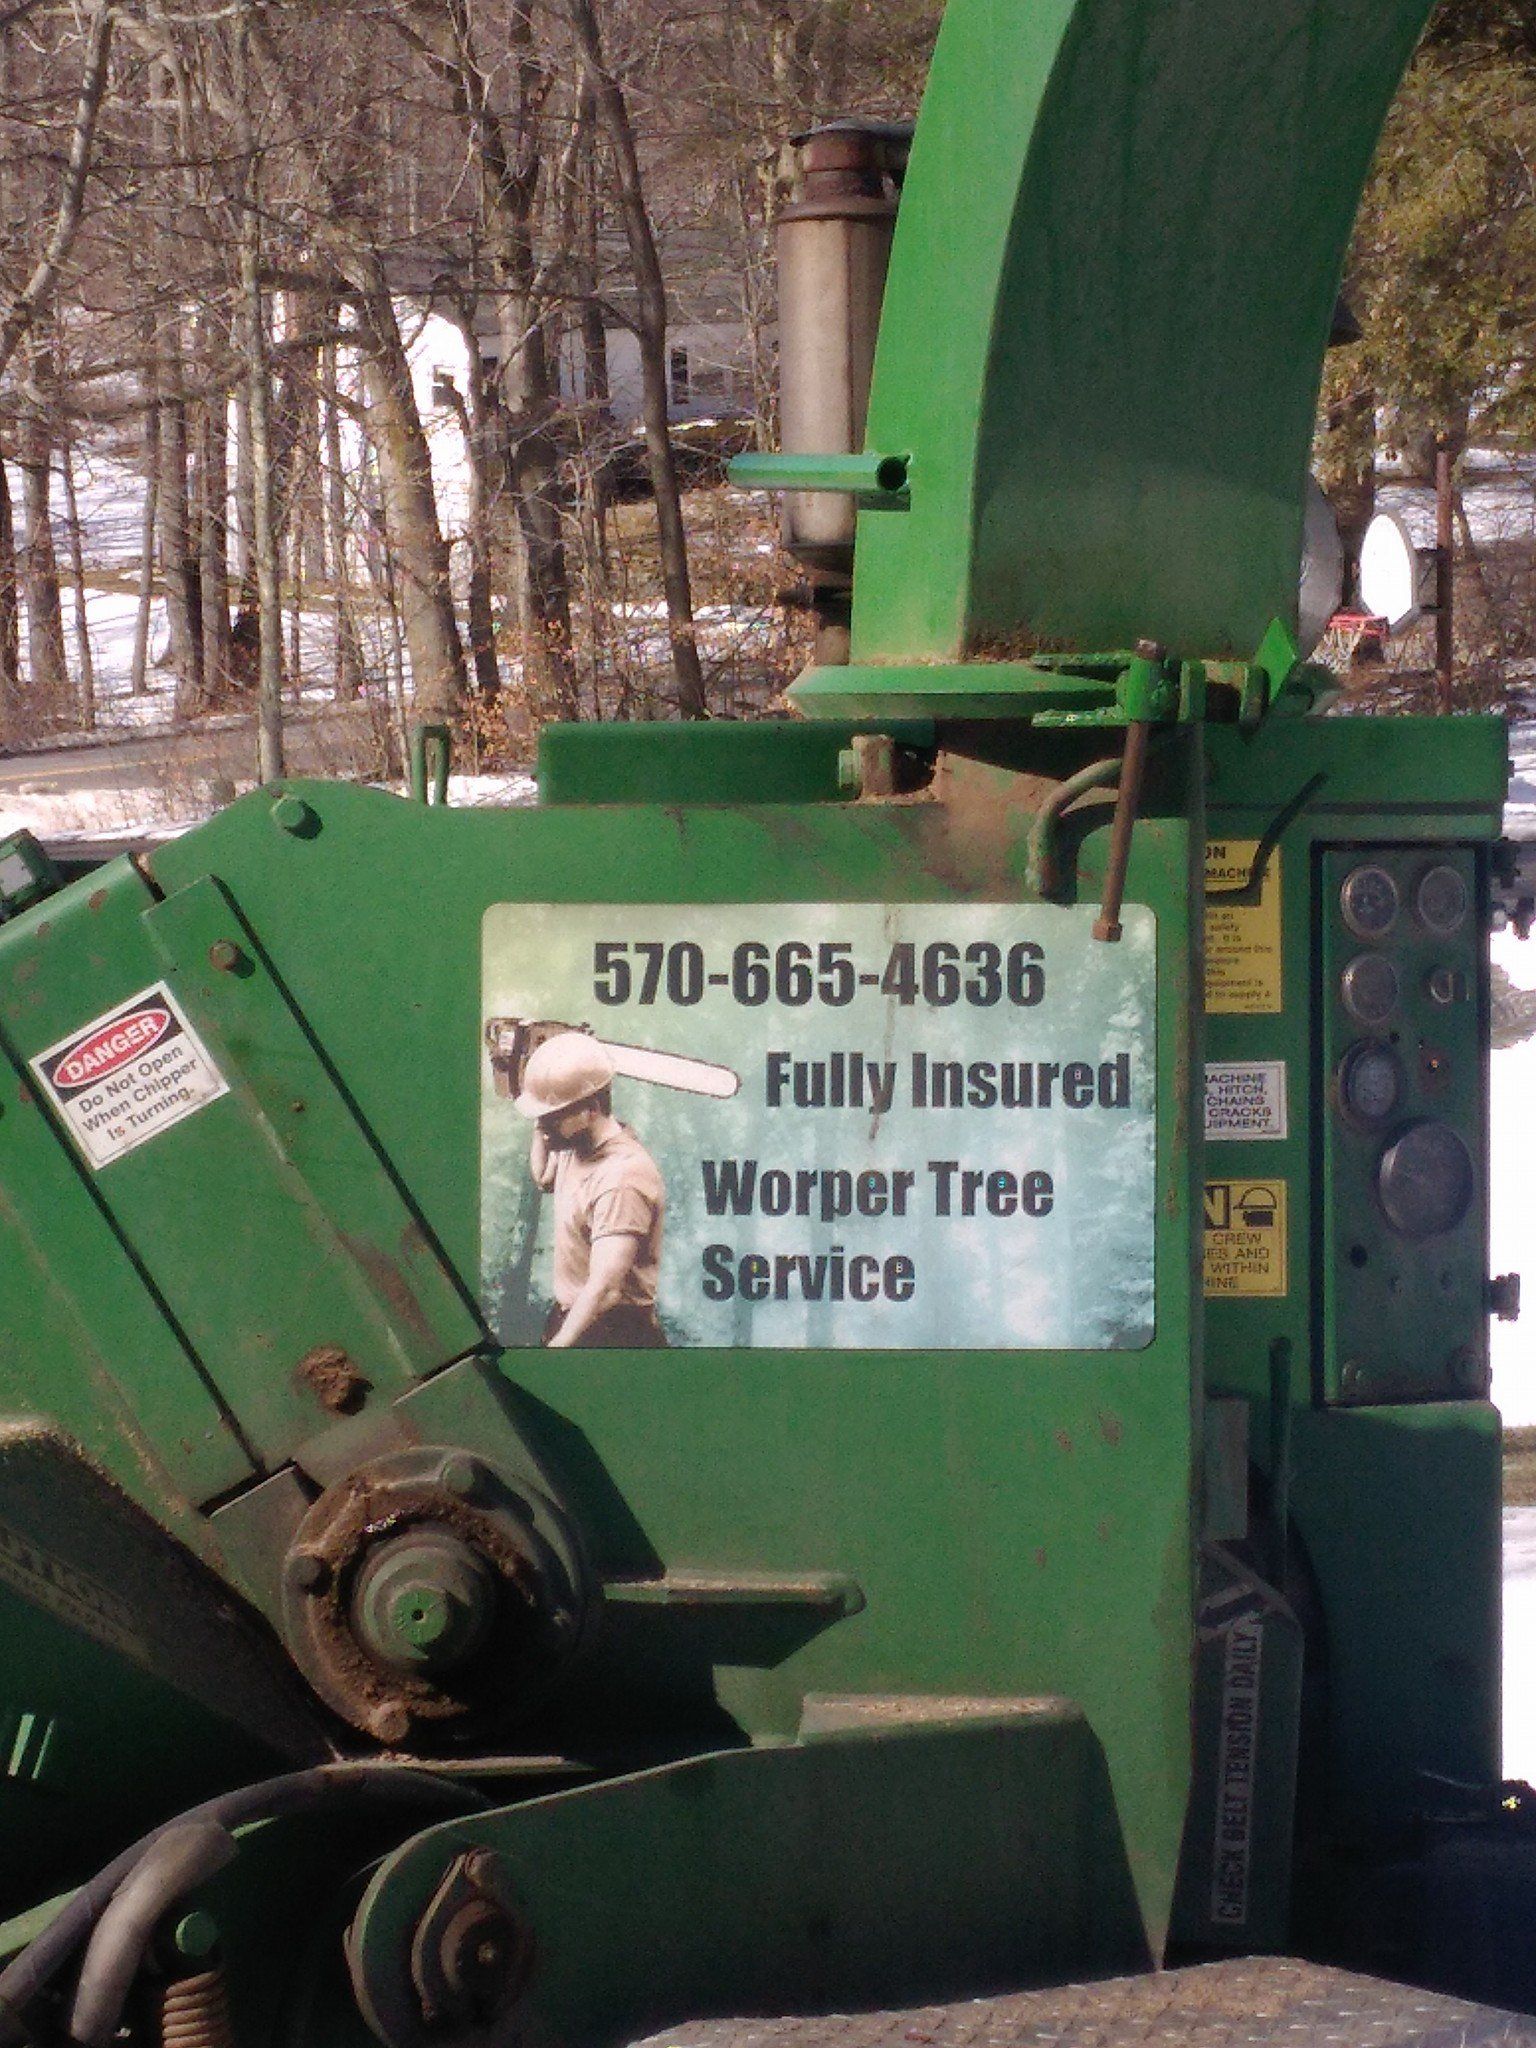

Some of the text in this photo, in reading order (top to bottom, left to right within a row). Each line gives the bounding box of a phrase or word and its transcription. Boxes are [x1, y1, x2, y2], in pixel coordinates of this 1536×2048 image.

[594, 942, 1046, 1006] 570-665-4636
[65, 1015, 161, 1081] DANGER
[78, 1045, 183, 1114] Do Not Open
[82, 1057, 198, 1132] When Chipper
[766, 1052, 1131, 1114] Fully Insured
[106, 1125, 126, 1141] Is
[702, 1161, 1054, 1223] Worper Tree
[1212, 1232, 1262, 1245] CREW
[1235, 1247, 1270, 1260] AND
[702, 1244, 915, 1302] Service
[1217, 1632, 1258, 1918] CHECK BELT TENSION DAILY
